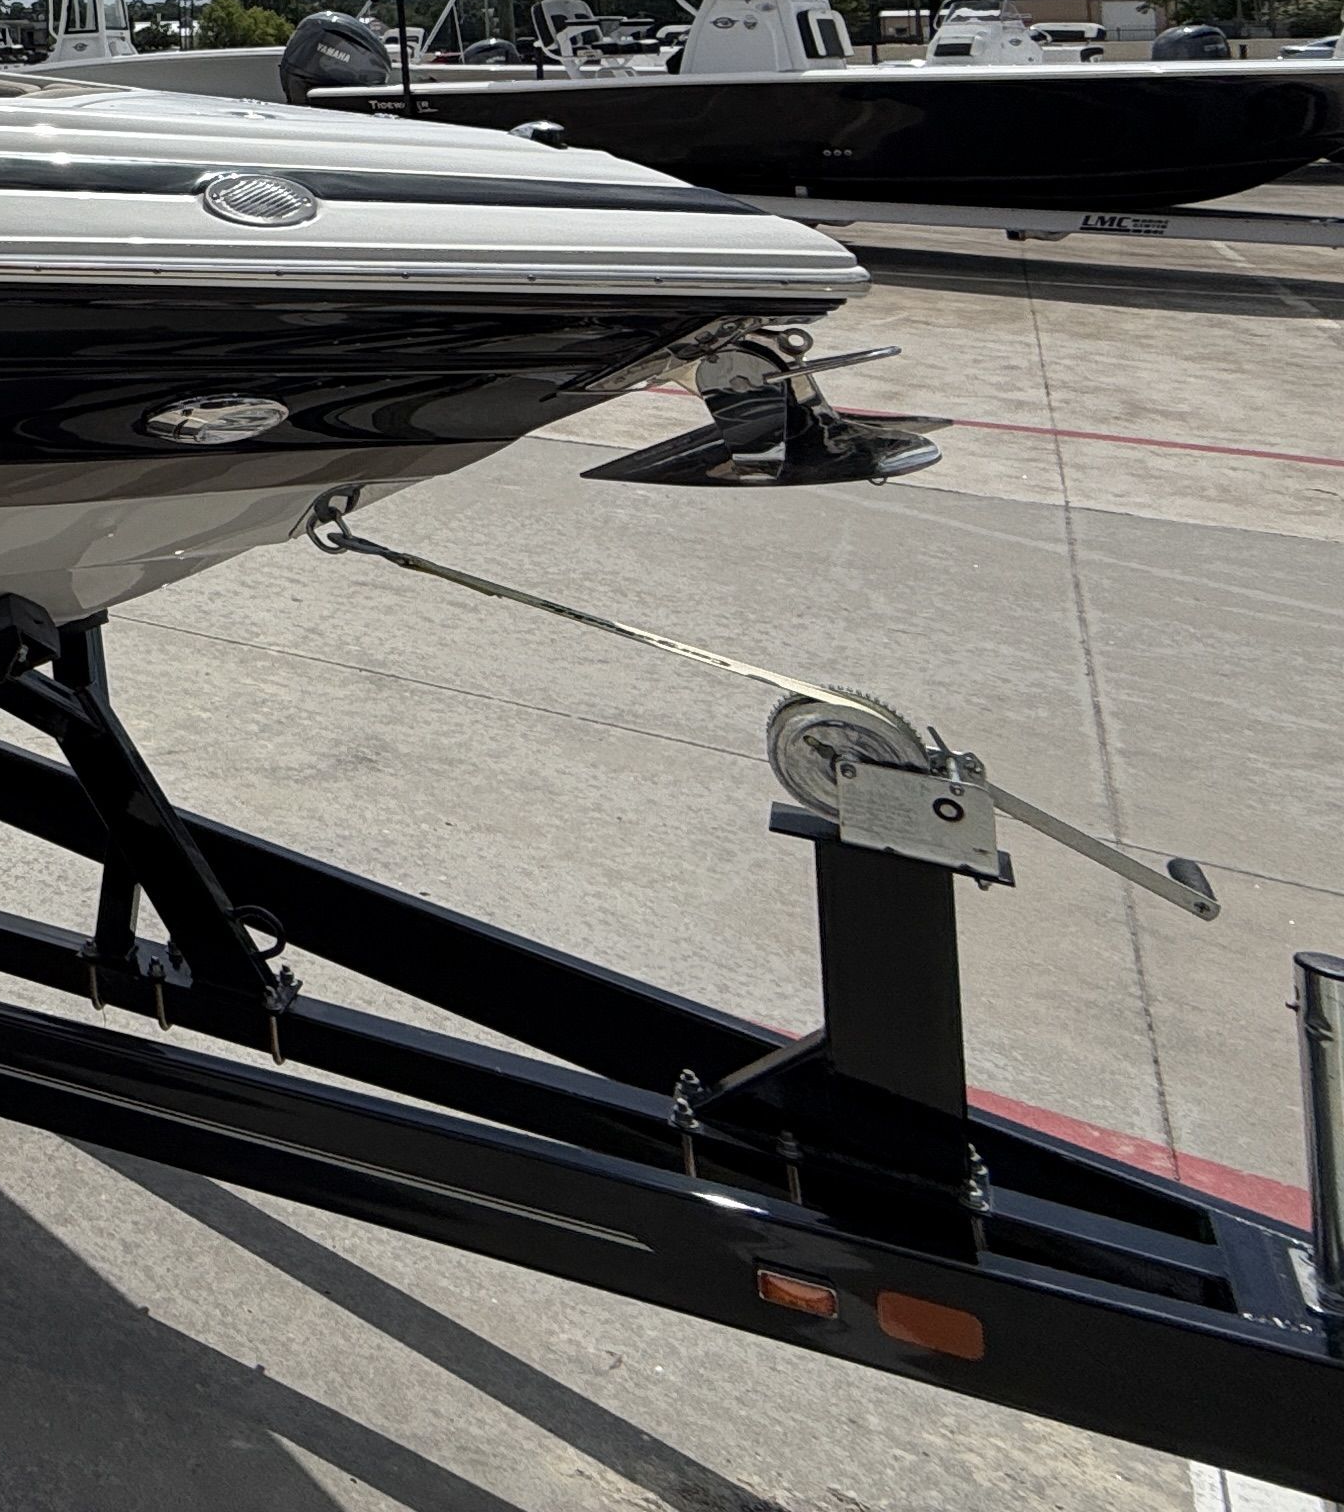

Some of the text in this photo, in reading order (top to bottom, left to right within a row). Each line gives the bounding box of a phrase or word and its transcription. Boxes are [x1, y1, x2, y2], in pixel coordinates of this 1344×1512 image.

[316, 42, 351, 63] YAMAHA
[367, 99, 429, 110] TIDEWER
[1082, 215, 1131, 228] LMC
